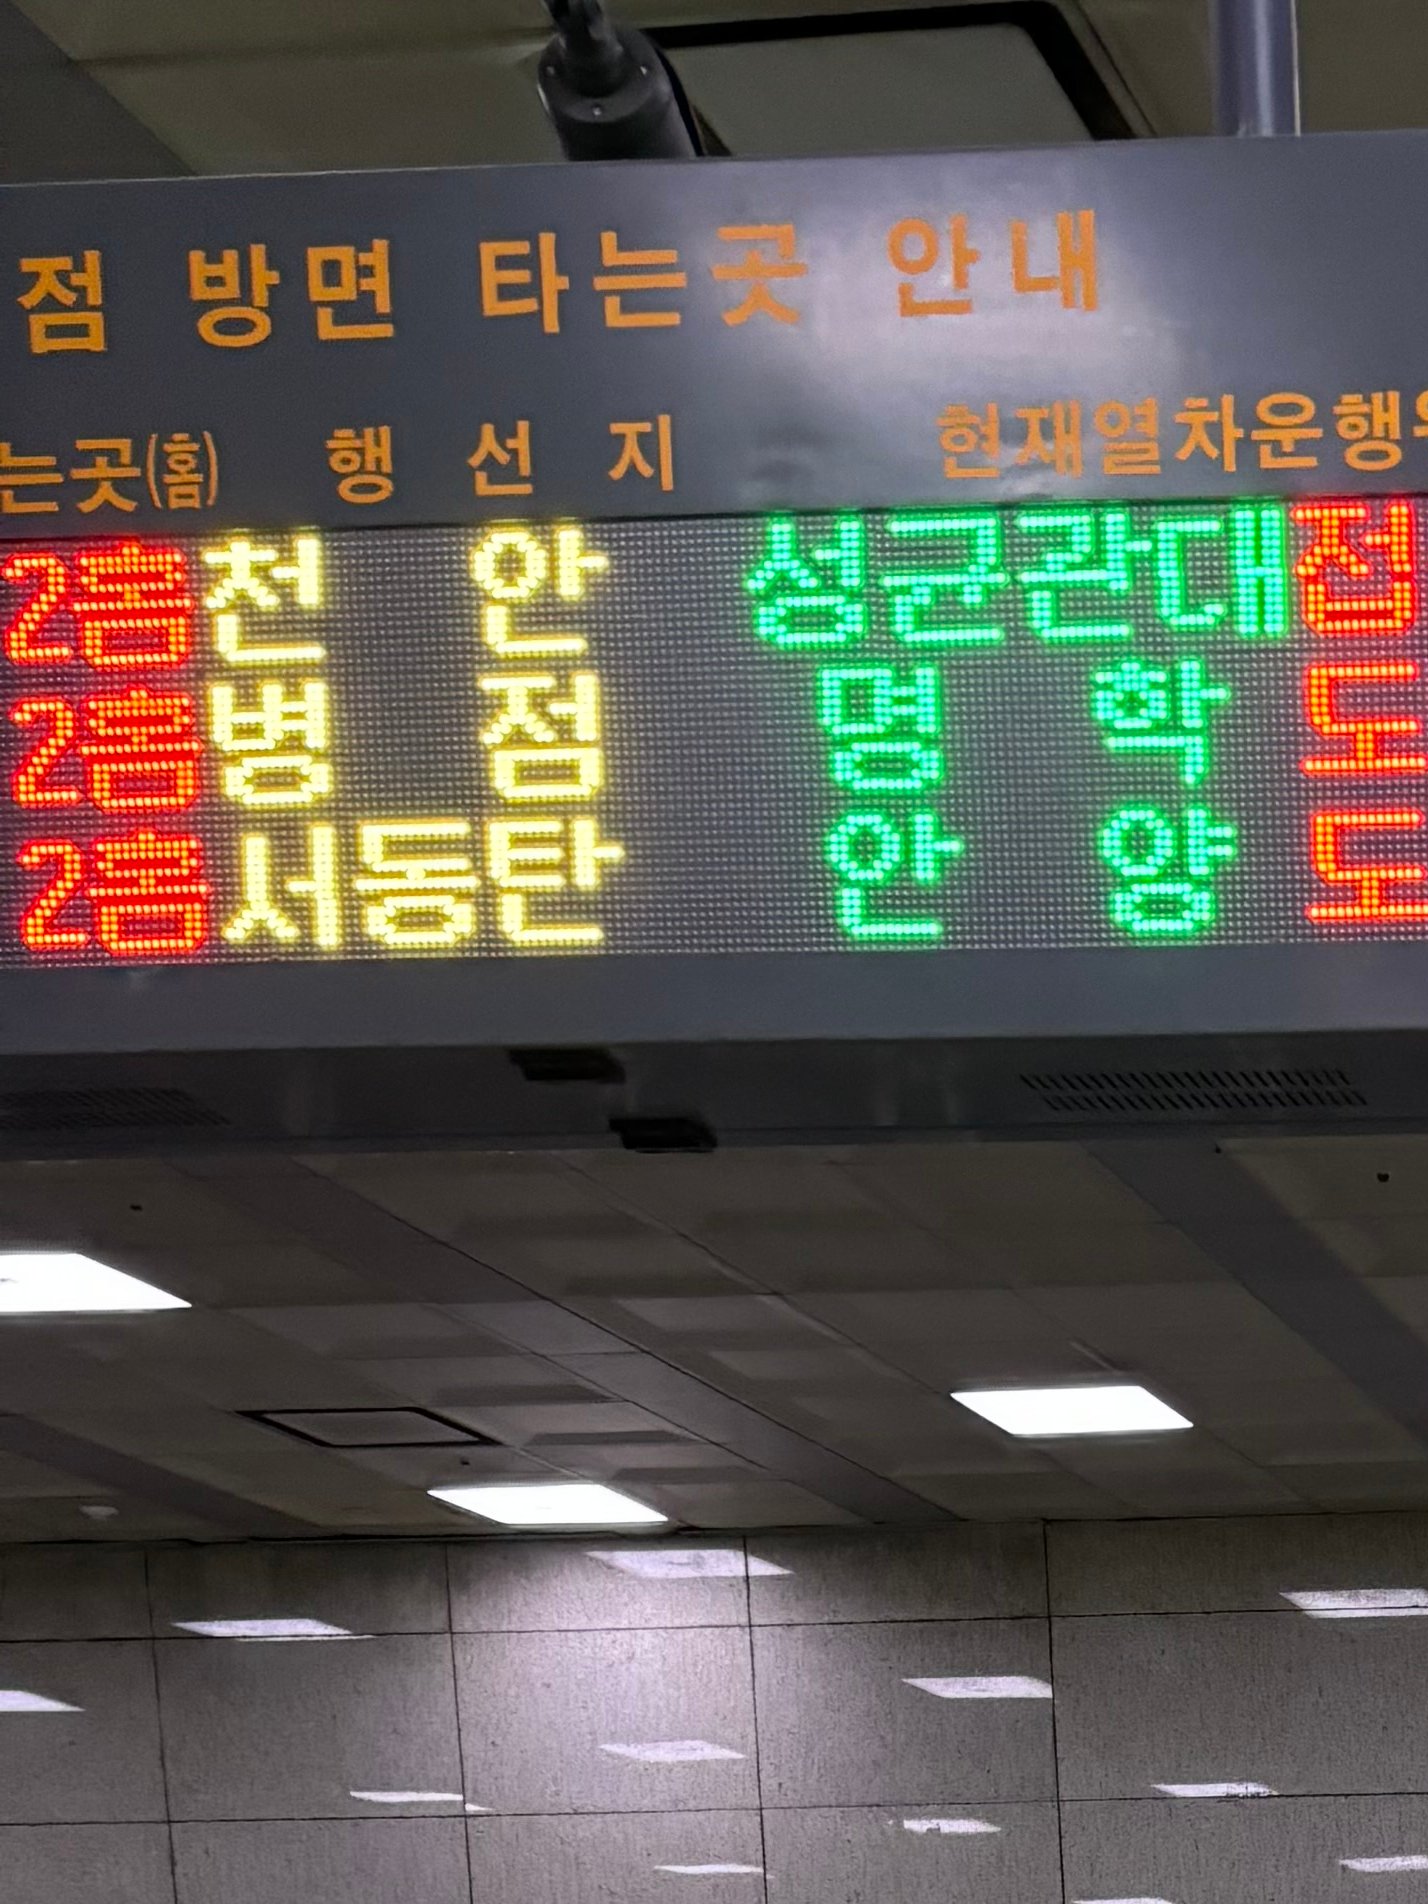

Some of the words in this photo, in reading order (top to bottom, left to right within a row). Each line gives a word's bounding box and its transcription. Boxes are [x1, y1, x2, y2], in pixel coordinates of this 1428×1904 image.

[18, 250, 109, 354] 점
[188, 239, 395, 348] 방면
[479, 223, 808, 335] 타는곳
[887, 208, 1100, 318] 안내
[745, 503, 1288, 648] 성균관대
[220, 816, 626, 952] 서동탄
